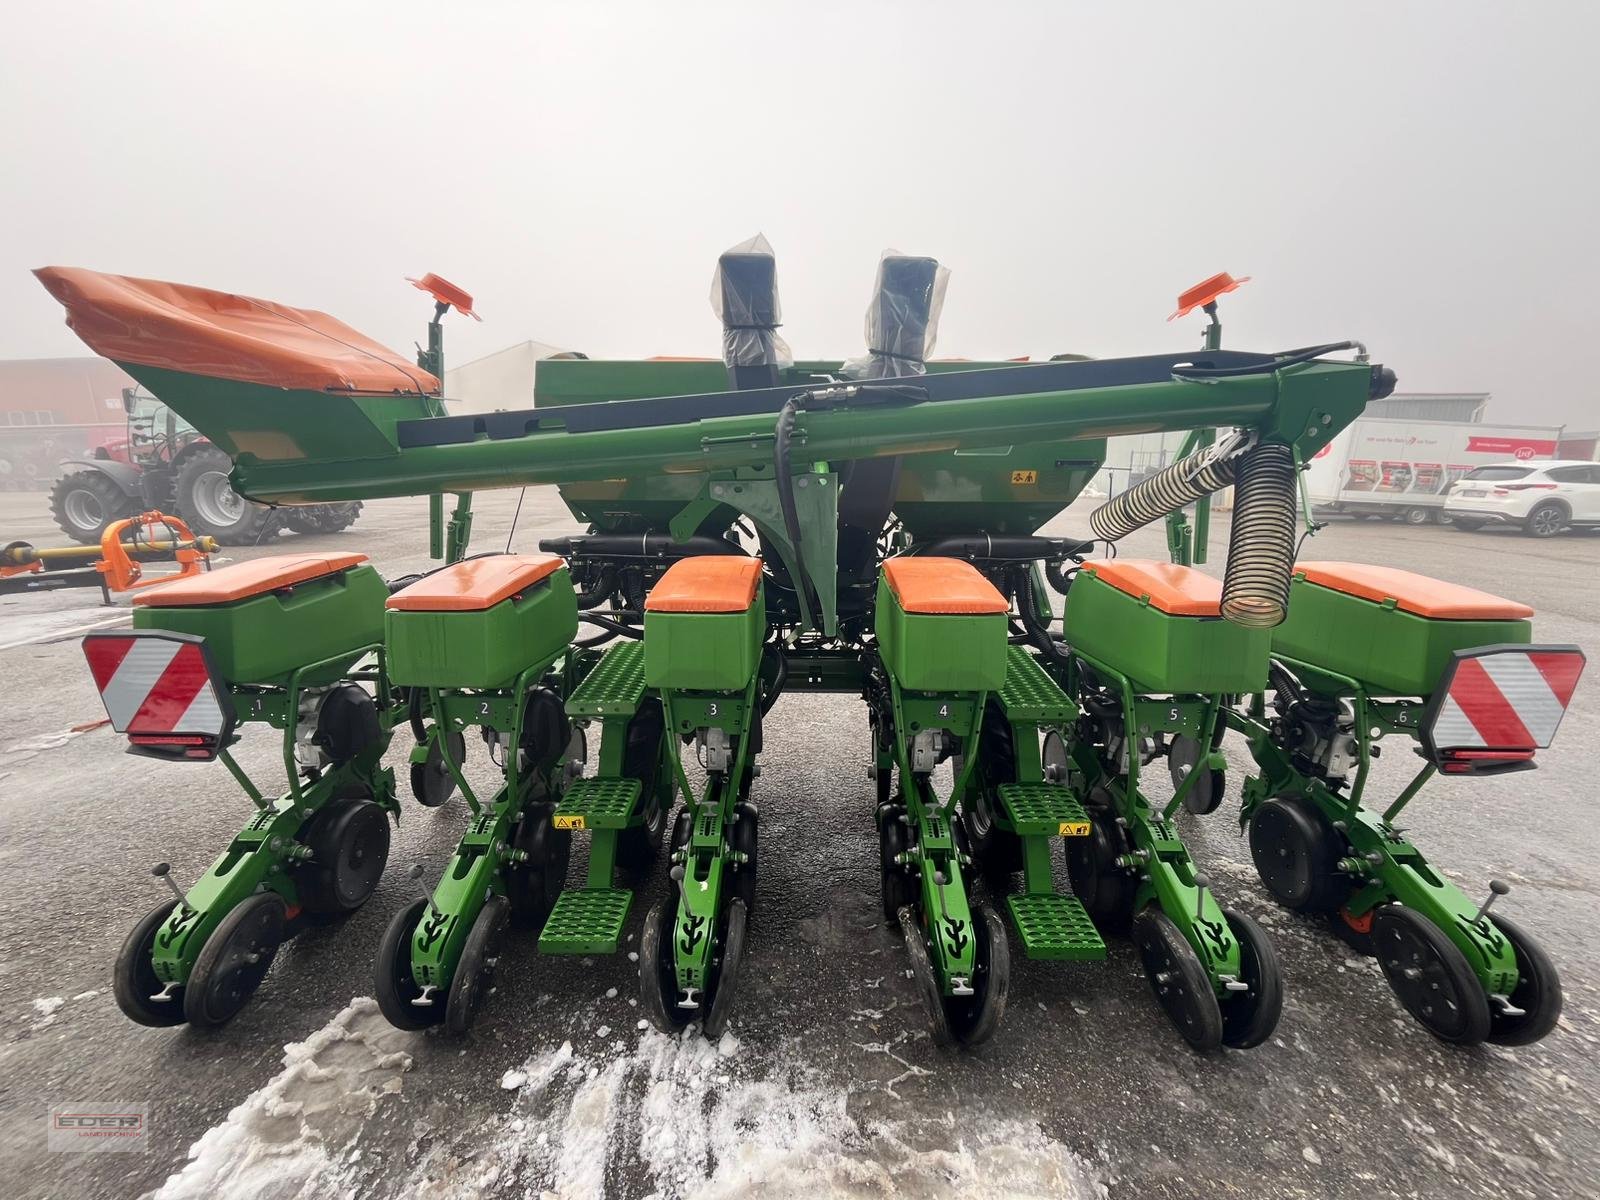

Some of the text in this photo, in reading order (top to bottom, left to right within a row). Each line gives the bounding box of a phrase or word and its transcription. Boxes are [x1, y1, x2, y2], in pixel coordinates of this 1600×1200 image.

[256, 699, 262, 710] 1
[481, 702, 489, 714] 2
[710, 703, 717, 715] 3
[939, 705, 948, 716] 4
[1170, 708, 1178, 720] 5
[1399, 711, 1407, 723] 6
